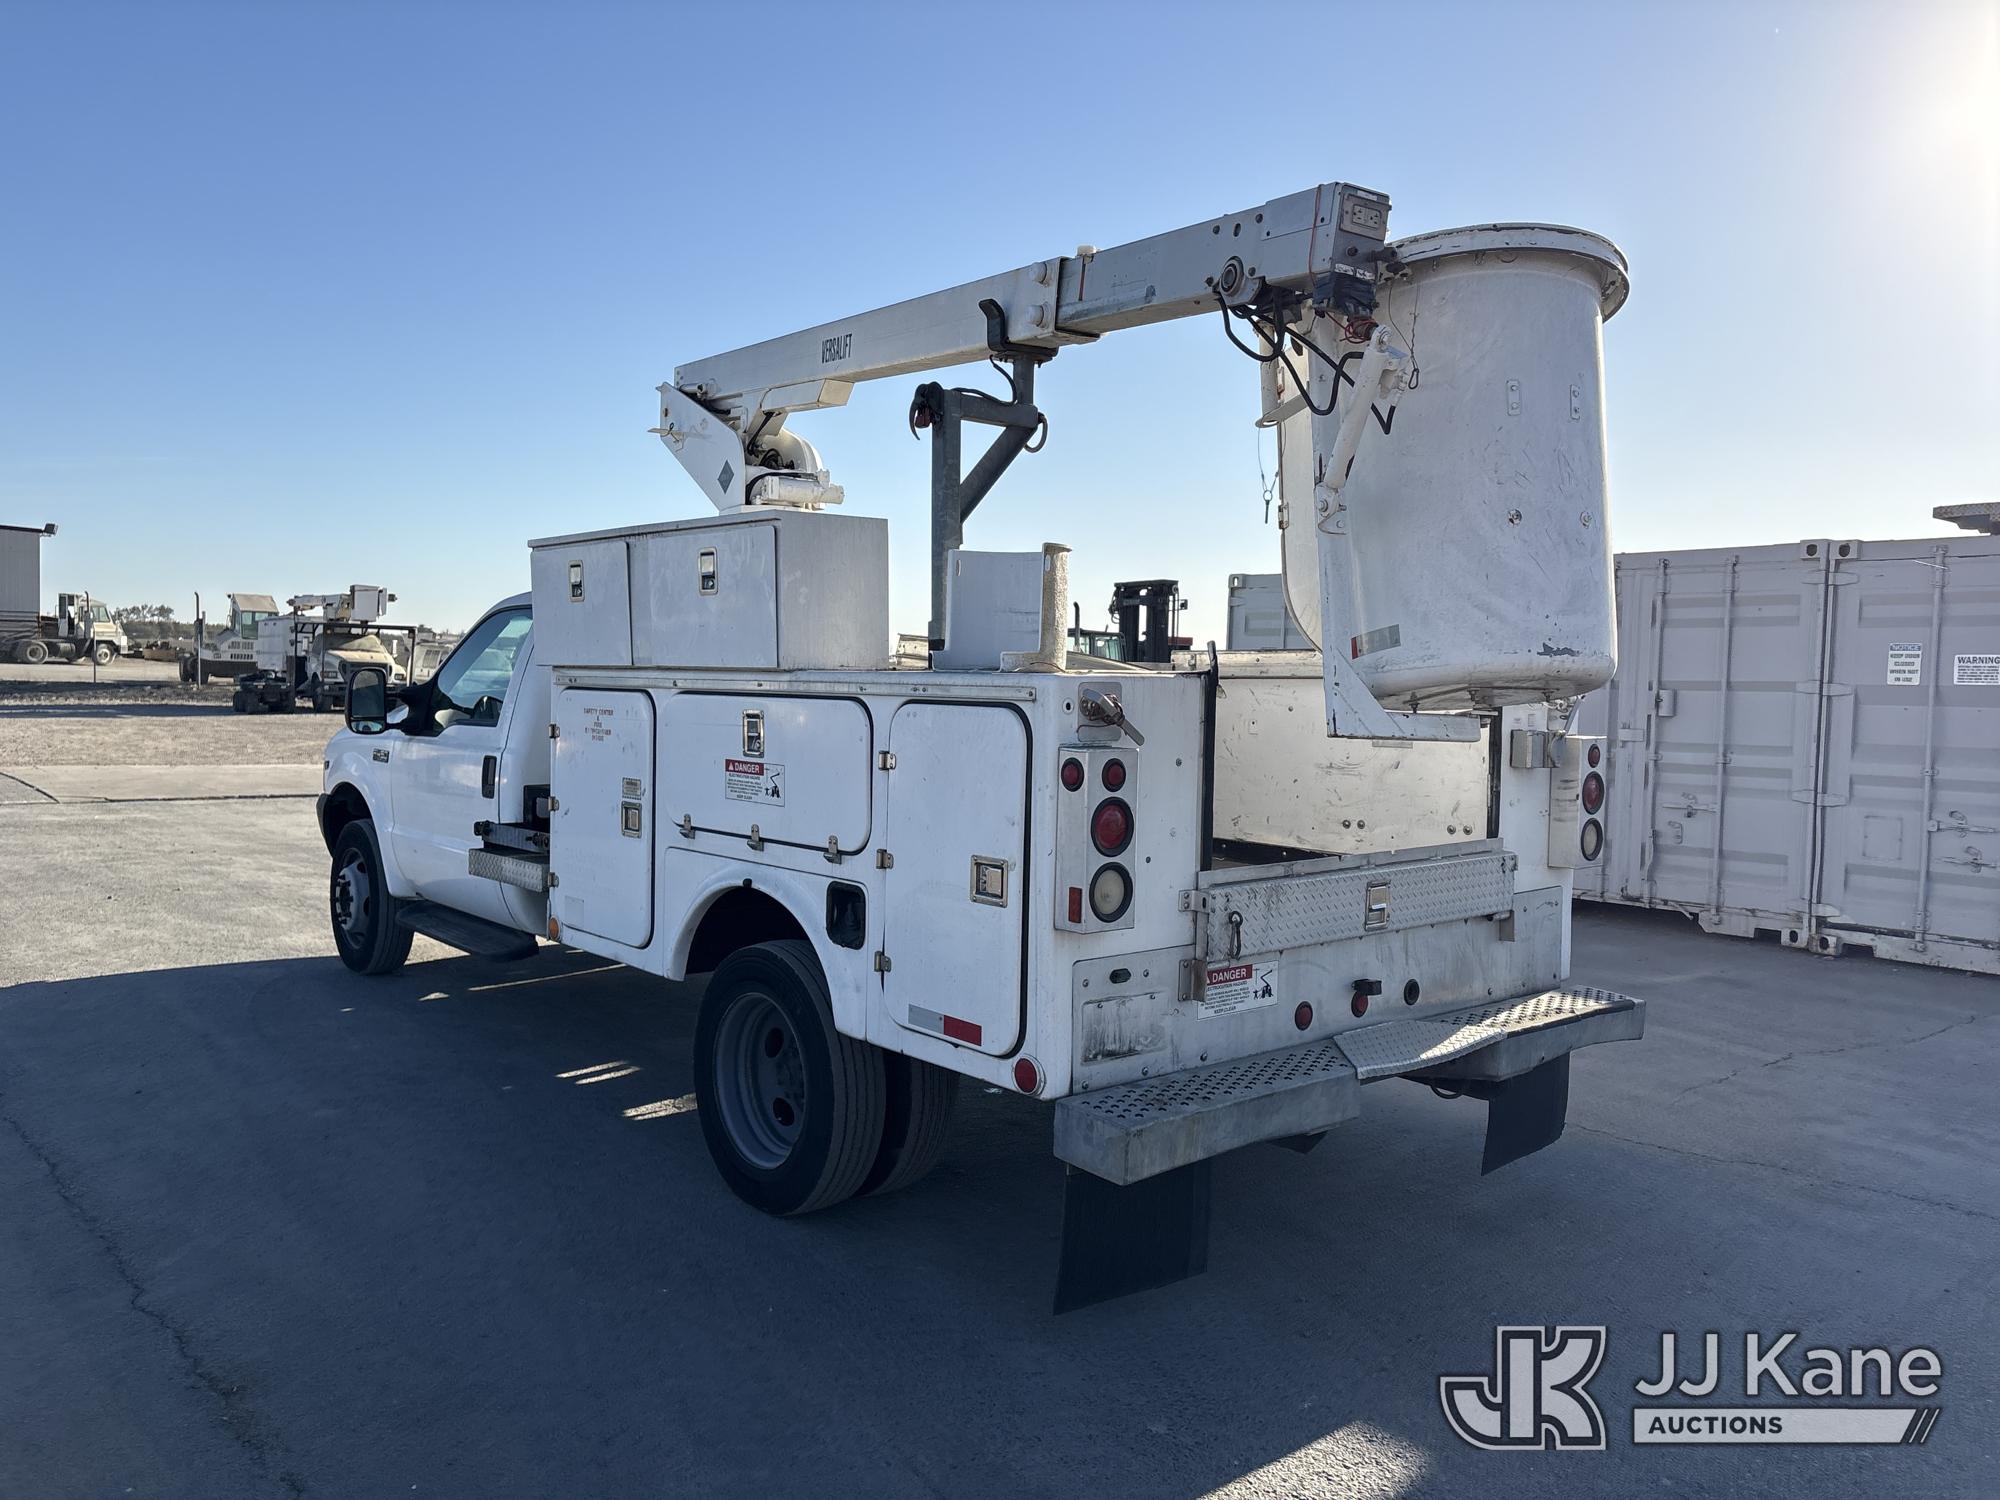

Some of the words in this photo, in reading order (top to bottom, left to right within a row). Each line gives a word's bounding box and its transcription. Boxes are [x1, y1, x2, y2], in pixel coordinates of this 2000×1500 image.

[822, 333, 852, 364] VERSALIFT
[1957, 656, 2000, 665] WARNING
[583, 707, 598, 715] SAFETY
[598, 708, 614, 716] CENTER
[734, 762, 760, 773] DANGER
[1212, 968, 1247, 983] DANGER
